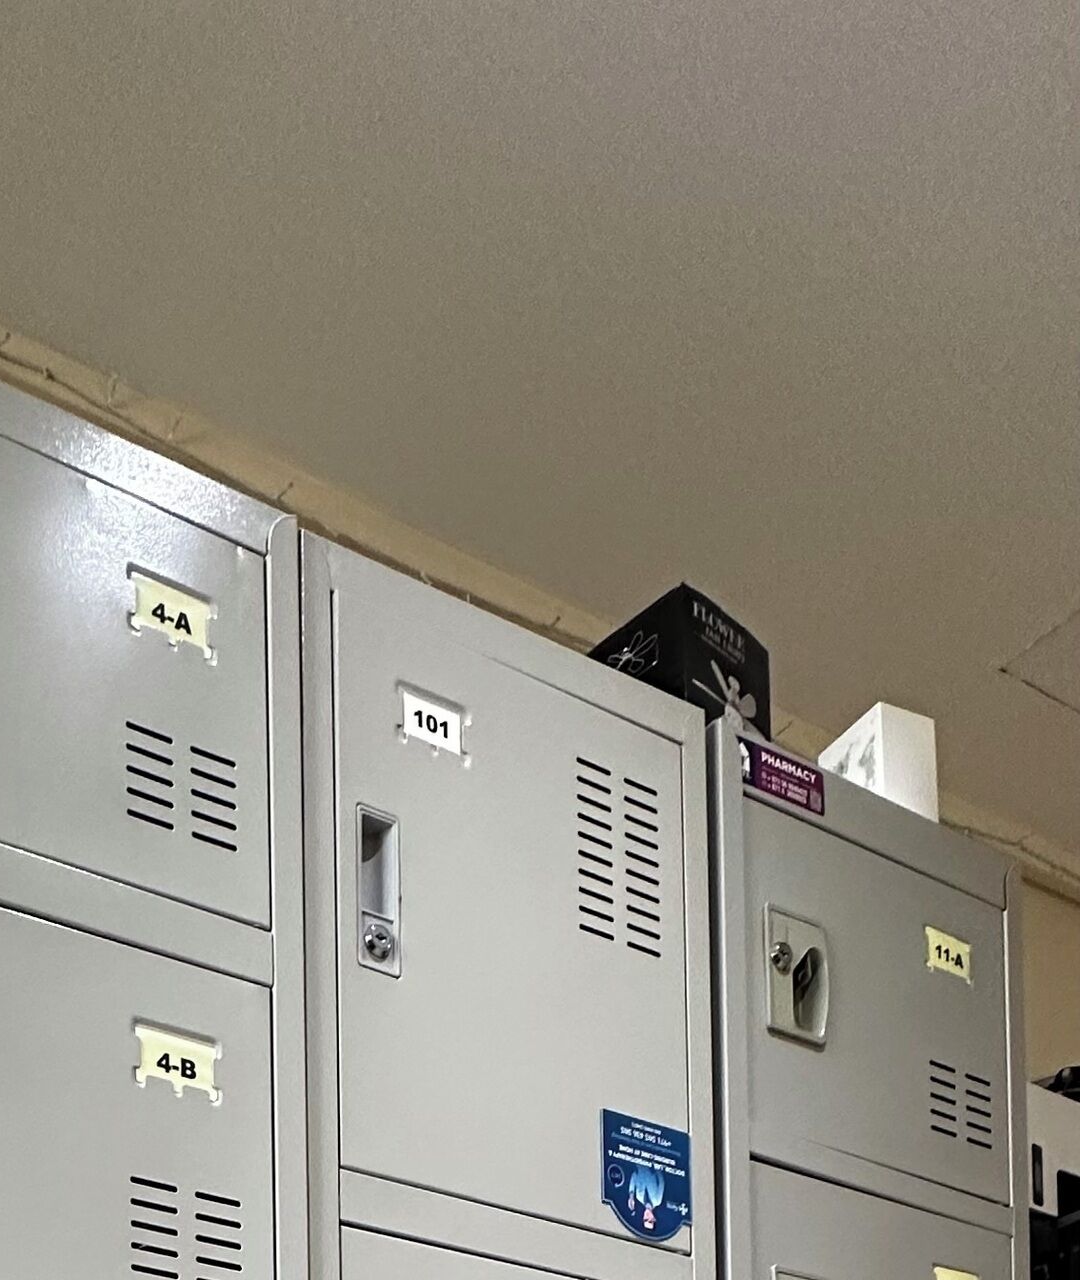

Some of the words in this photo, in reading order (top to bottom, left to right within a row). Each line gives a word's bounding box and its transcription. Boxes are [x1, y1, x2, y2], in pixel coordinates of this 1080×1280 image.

[151, 602, 192, 636] 4-A
[413, 709, 449, 740] 101
[761, 751, 816, 784] PHARMACY
[935, 944, 964, 970] 11-A
[156, 1052, 197, 1080] 4-B
